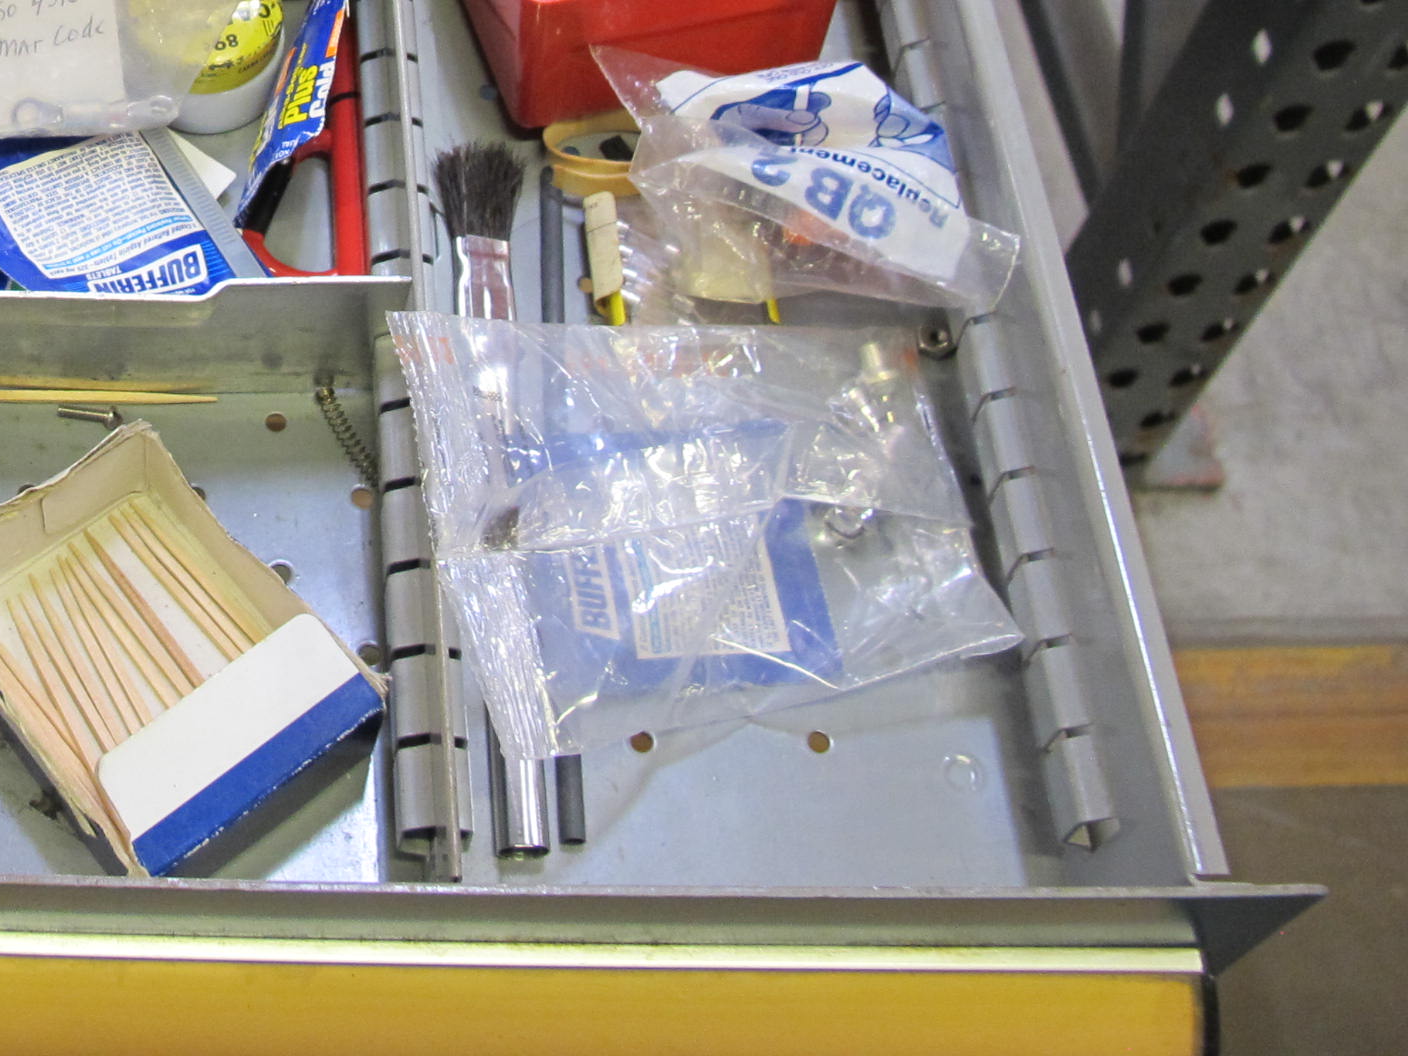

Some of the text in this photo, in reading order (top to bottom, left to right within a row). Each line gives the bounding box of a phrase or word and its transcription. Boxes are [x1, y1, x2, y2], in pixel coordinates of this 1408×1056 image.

[283, 65, 320, 126] Plus
[803, 167, 897, 239] QB
[93, 251, 202, 294] BUFFERIN
